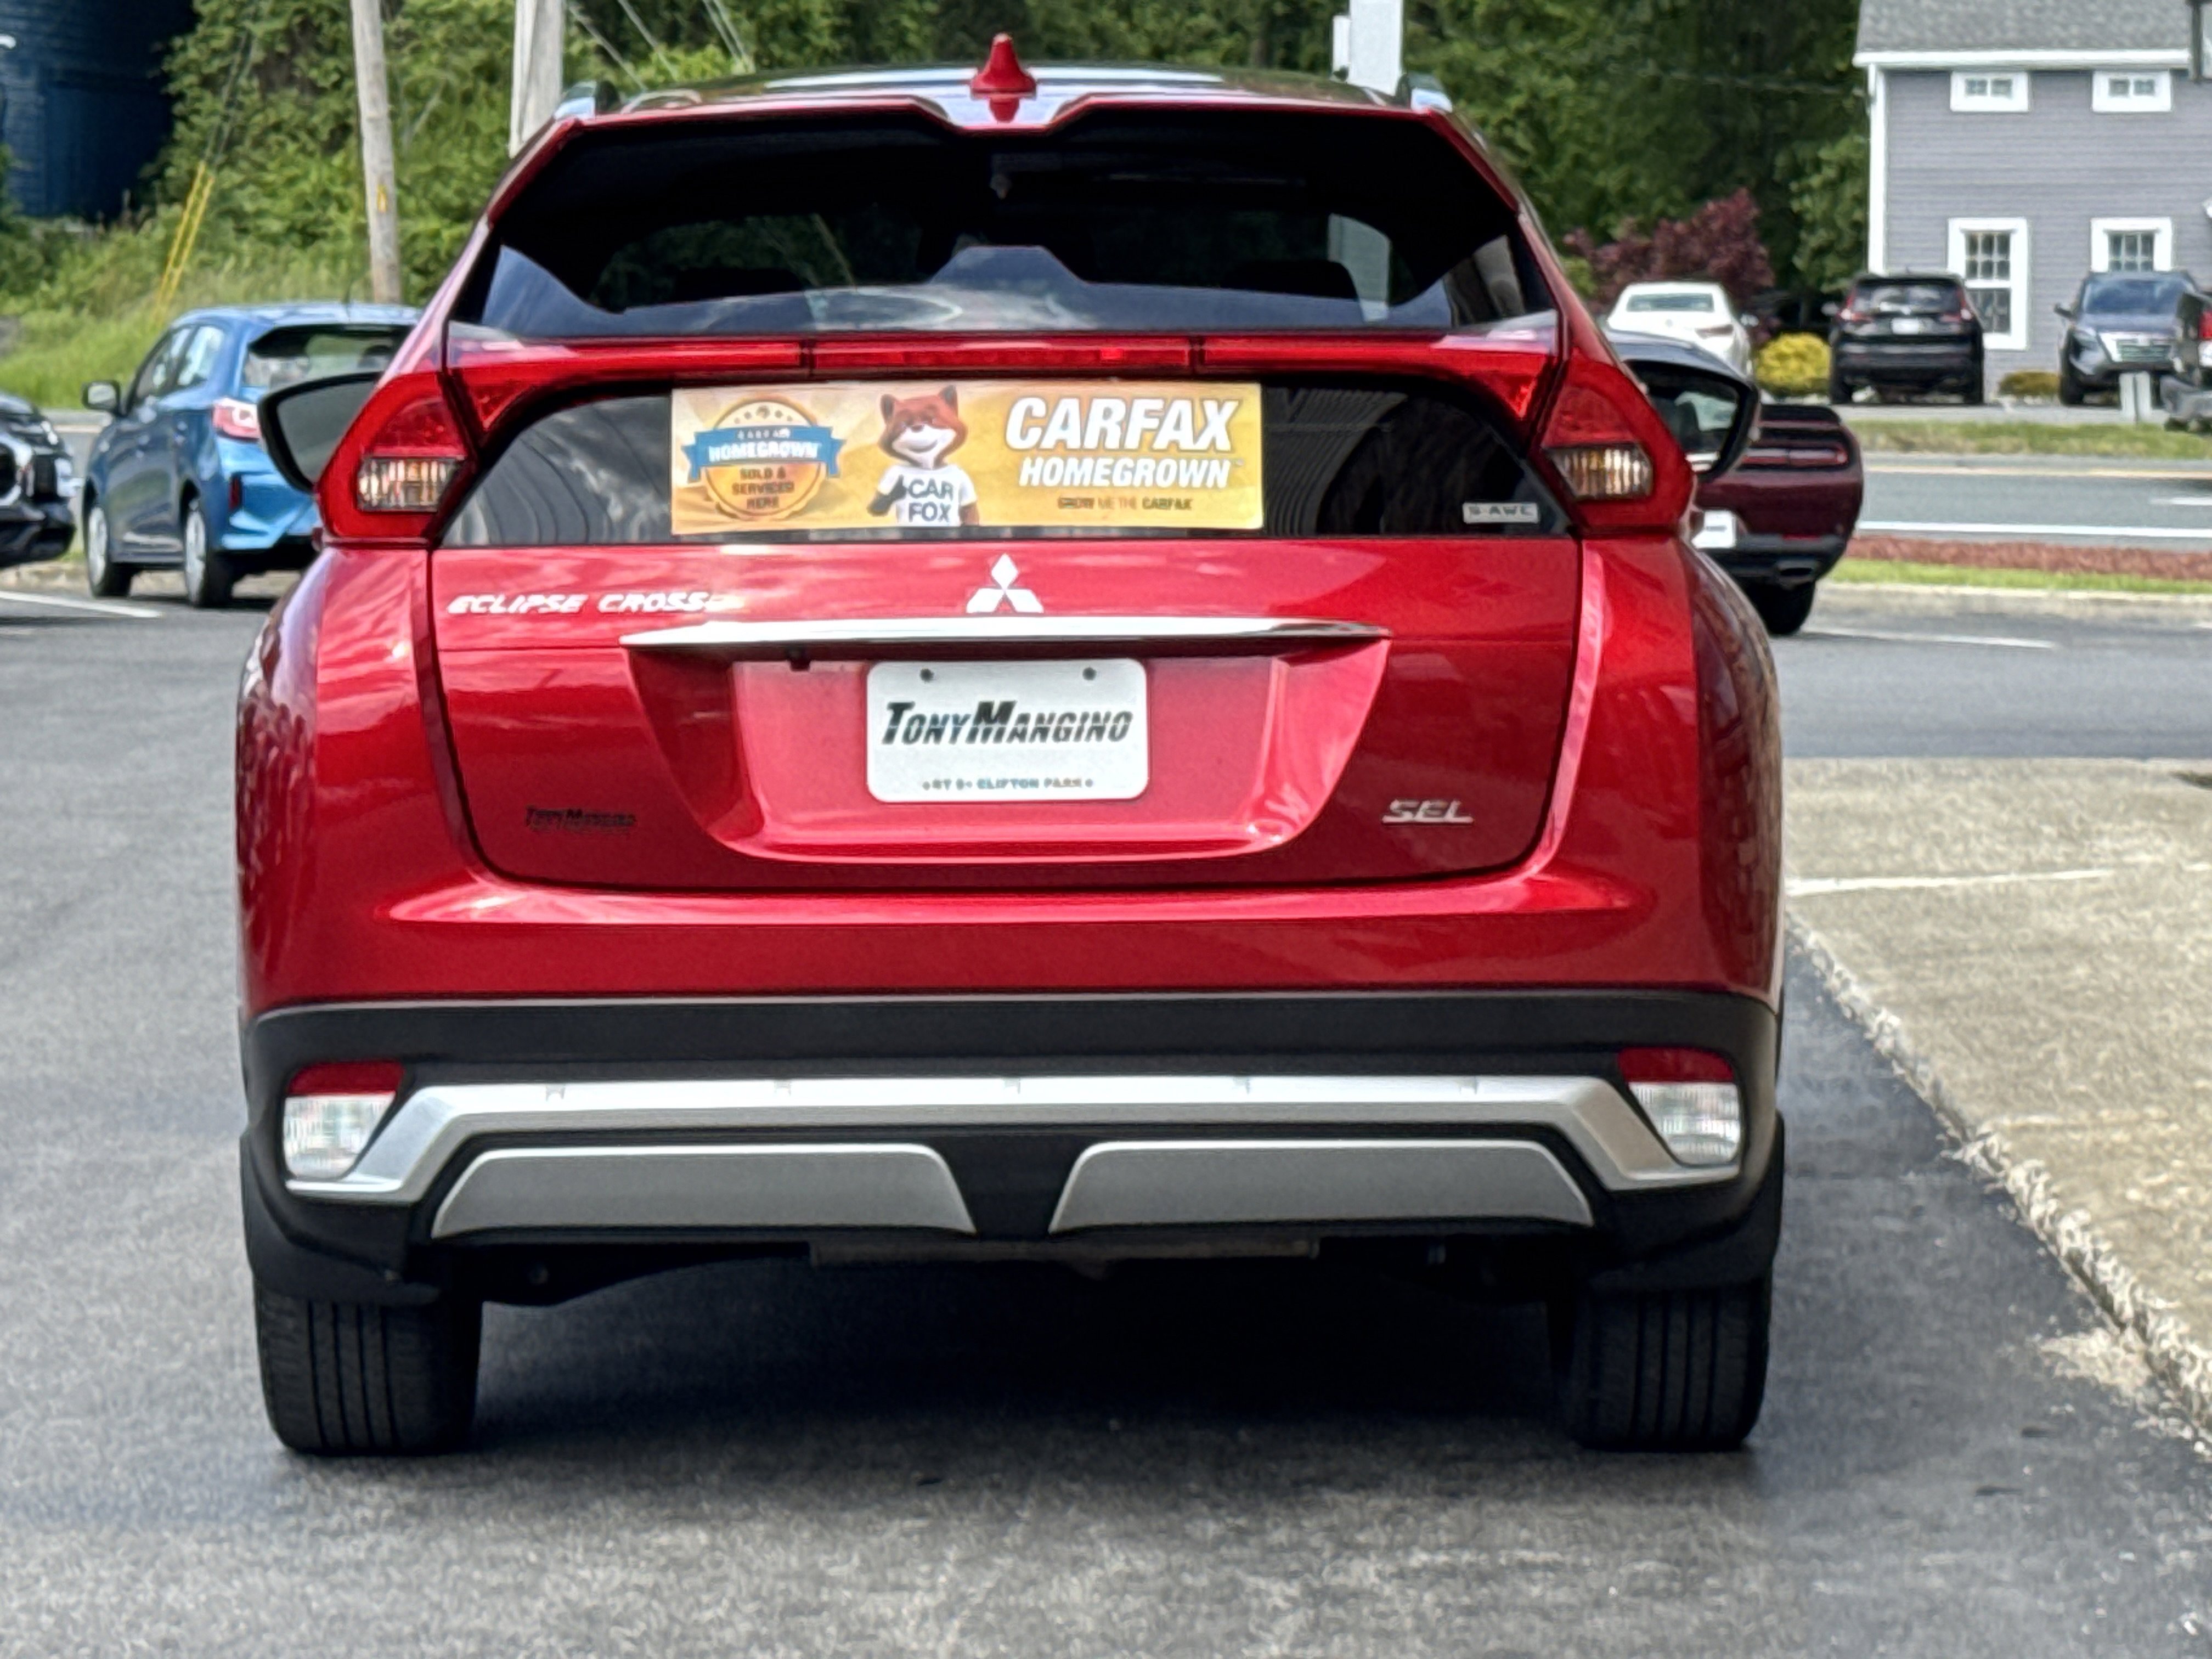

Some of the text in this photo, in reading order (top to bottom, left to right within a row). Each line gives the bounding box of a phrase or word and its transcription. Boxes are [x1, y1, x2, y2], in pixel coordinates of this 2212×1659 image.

[1005, 396, 1240, 452] CARFAX
[1019, 457, 1232, 488] HOMEGROWN
[908, 478, 953, 500] CAR
[908, 502, 951, 522] FOX
[447, 592, 709, 613] ECLIPSE CROSS
[1382, 799, 1474, 823] SEL
